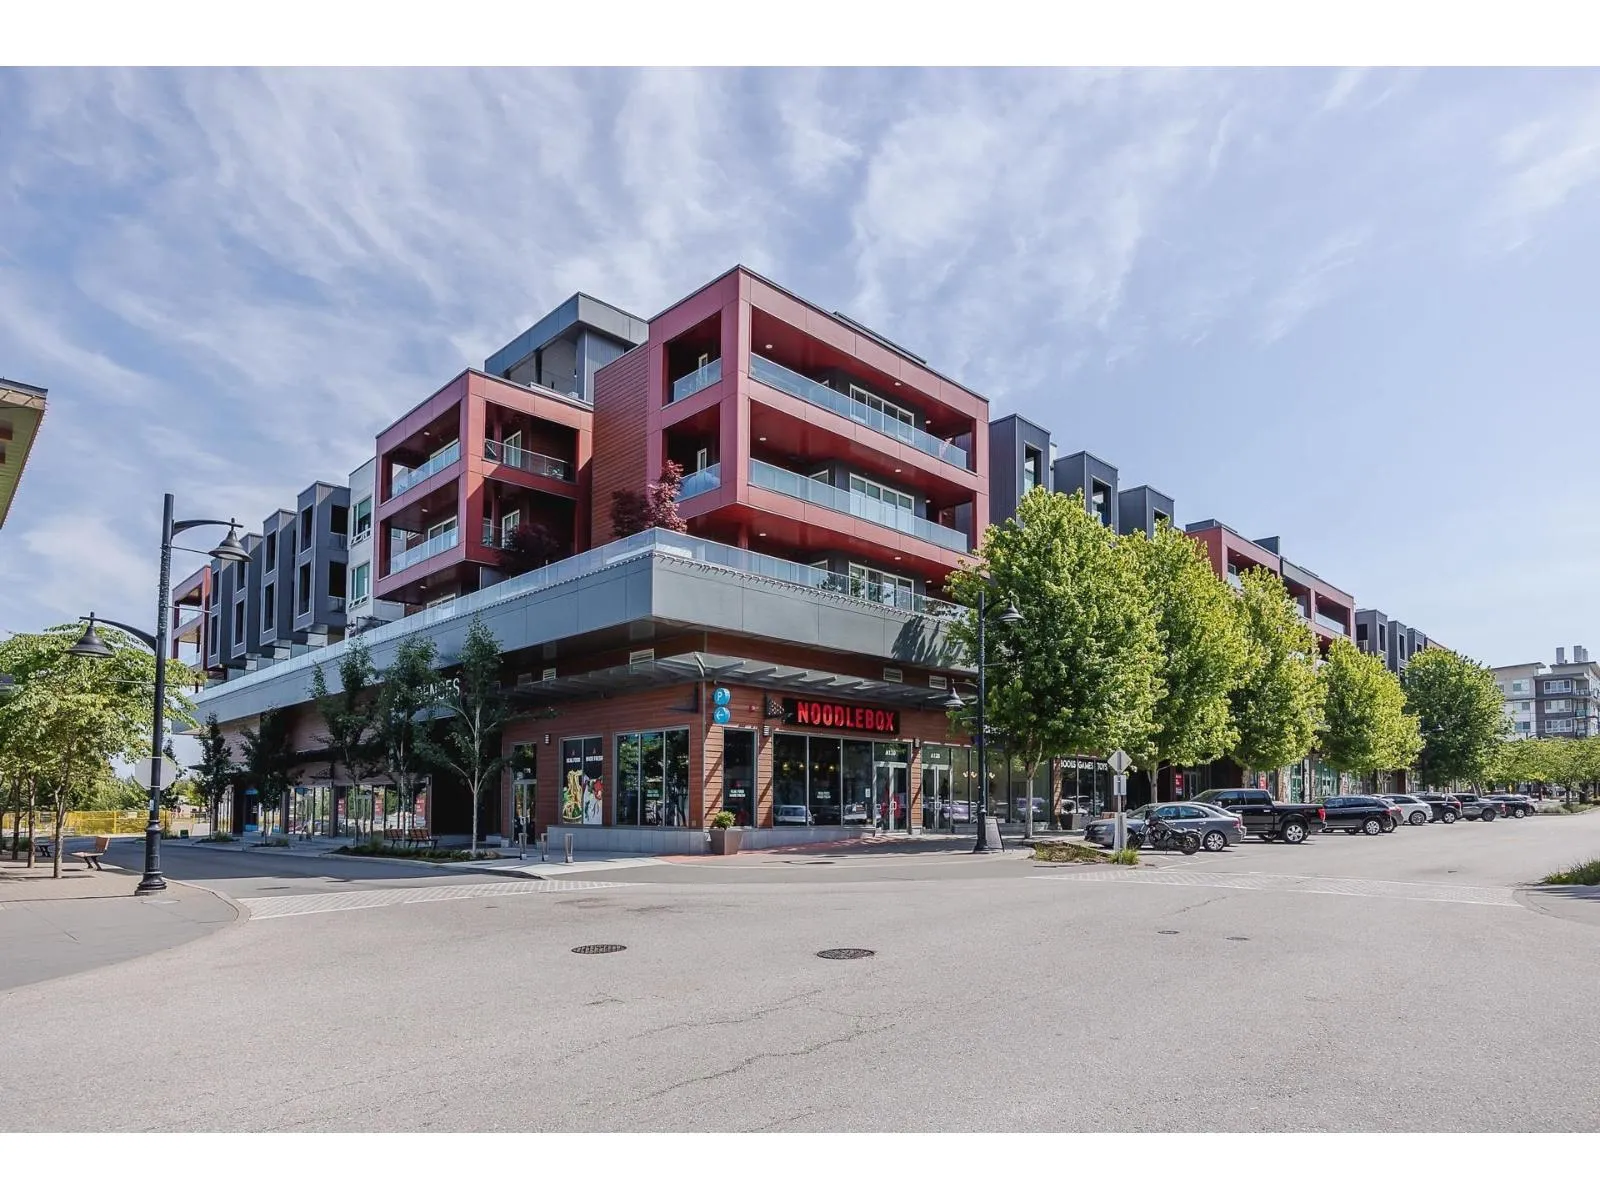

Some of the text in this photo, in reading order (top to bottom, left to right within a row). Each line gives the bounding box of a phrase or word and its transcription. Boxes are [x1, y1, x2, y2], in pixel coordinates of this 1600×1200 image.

[797, 701, 895, 732] NOODLEBOX
[1078, 760, 1094, 770] GAMES
[1096, 762, 1108, 771] TOYS
